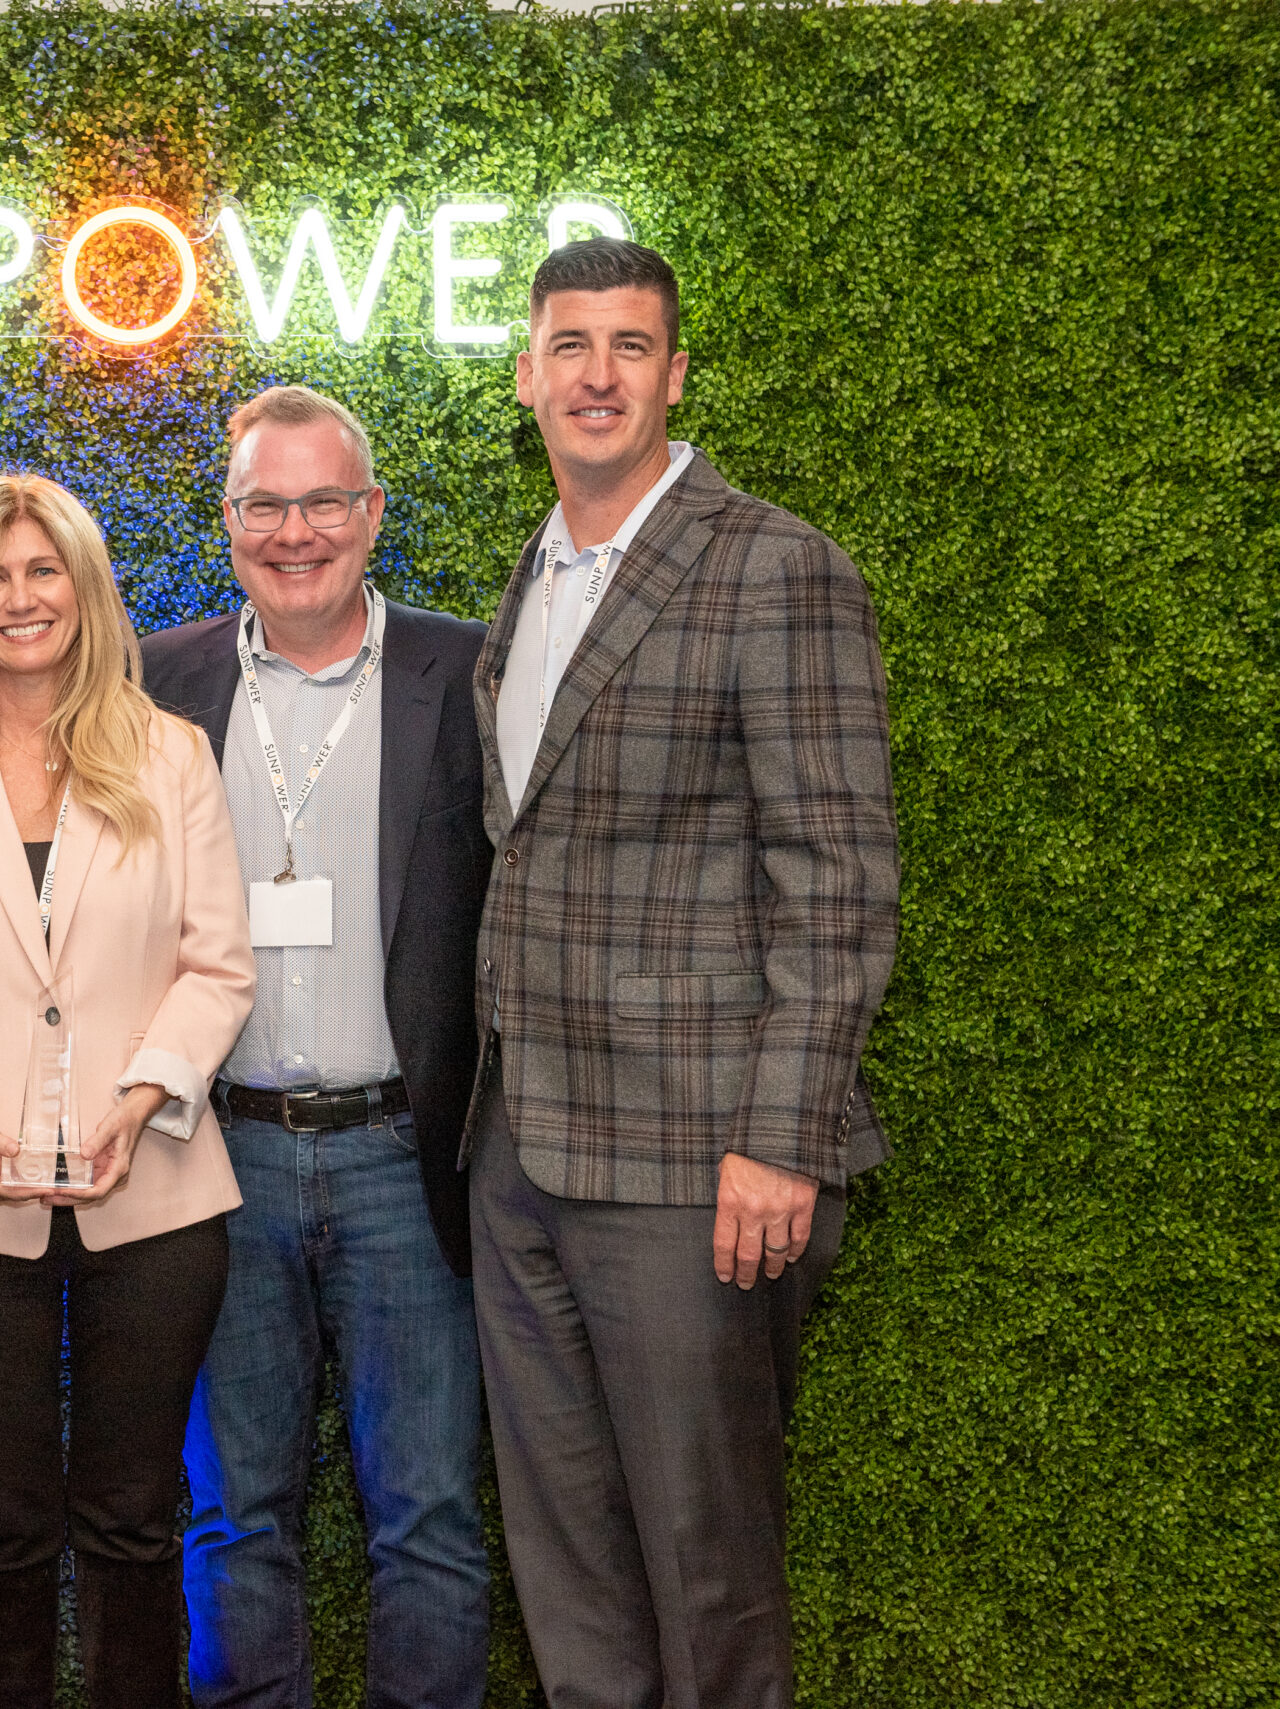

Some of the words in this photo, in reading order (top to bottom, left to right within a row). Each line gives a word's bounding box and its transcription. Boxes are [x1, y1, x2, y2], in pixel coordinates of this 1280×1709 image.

[585, 540, 615, 604] SUNPOW
[264, 743, 290, 812] SUNPOWER
[40, 870, 55, 930] SUNPOW
